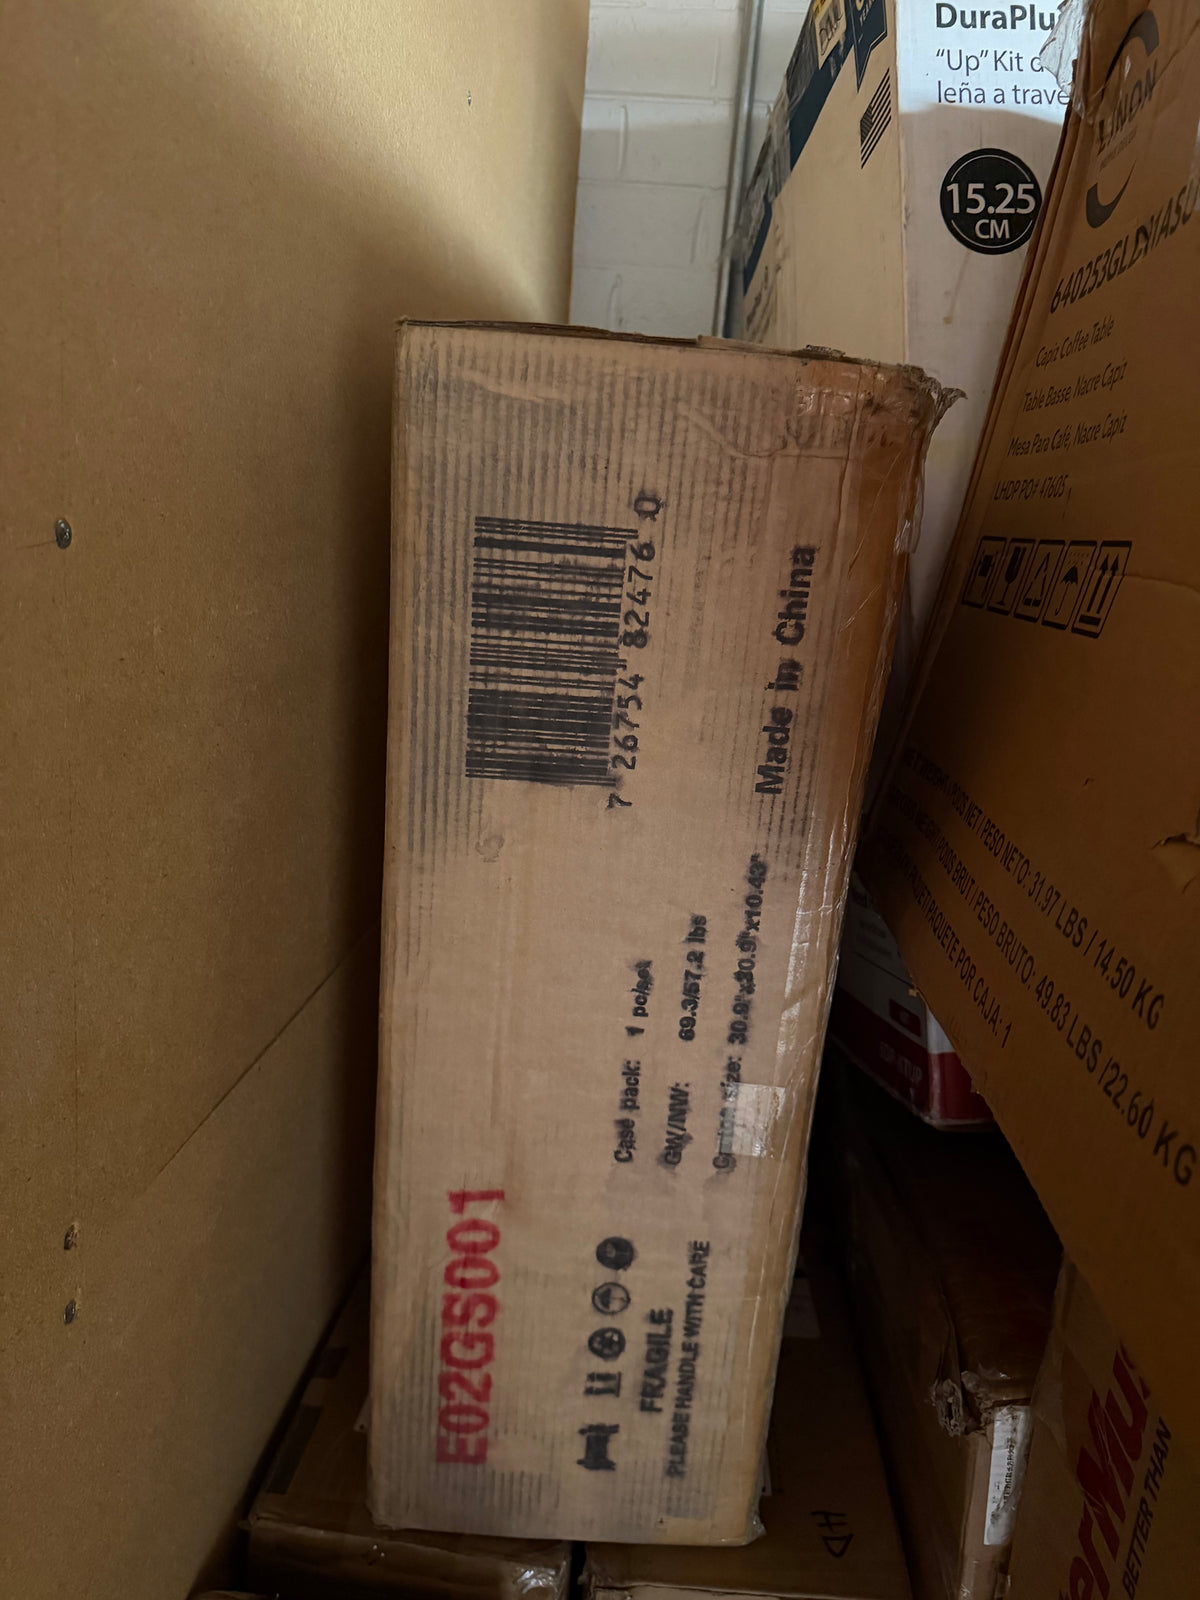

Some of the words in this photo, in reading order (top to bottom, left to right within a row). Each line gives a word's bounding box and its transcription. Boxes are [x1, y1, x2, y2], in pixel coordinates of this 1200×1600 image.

[936, 3, 1056, 31] DuraPlu
[994, 50, 1024, 72] Kit
[938, 80, 985, 104] leña
[993, 88, 1005, 104] a
[1012, 85, 1070, 105] trave
[946, 183, 1036, 215] 15.25
[975, 219, 1010, 239] CM
[1060, 330, 1089, 360] Coffee
[1091, 315, 1114, 344] Table
[1023, 388, 1044, 413] Table
[1045, 386, 1072, 408] Basse
[1073, 374, 1100, 399] Nacre
[1007, 437, 1031, 457] Mesa
[1031, 433, 1050, 454] Para
[1073, 422, 1100, 446] Nacre
[633, 495, 661, 520] 0
[620, 541, 656, 650] 82476
[773, 544, 818, 646] China
[766, 659, 804, 691] in
[611, 673, 645, 771] 26754
[755, 706, 794, 794] Made
[605, 793, 633, 810] 7
[687, 914, 708, 944] lbs
[963, 800, 983, 831] NET
[980, 817, 1005, 858] PESO
[999, 840, 1032, 889] NETO:
[1028, 871, 1061, 917] 31.97
[1055, 900, 1088, 948] LBS
[1093, 938, 1136, 999] 14.50
[1131, 978, 1165, 1031] KG
[954, 947, 977, 991] POR
[972, 977, 1003, 1037] CAJA:
[1001, 1021, 1013, 1049] 1
[625, 1025, 645, 1037] 1
[951, 859, 976, 901] BRUT
[973, 890, 1000, 937] PESO
[996, 920, 1037, 991] BRUTO:
[1034, 975, 1071, 1032] 49.83
[1066, 1013, 1103, 1074] LBS
[1152, 1120, 1197, 1187] KG
[621, 1060, 641, 1111] pack:
[613, 1118, 637, 1164] Case
[687, 1240, 711, 1290] CARE
[435, 1189, 505, 1465] E02GS001
[683, 1293, 705, 1340] WITH
[640, 1308, 675, 1413] FRAGILE
[675, 1341, 699, 1409] HANDLE
[666, 1411, 691, 1478] PLEASE
[1122, 1496, 1154, 1600] BETTER
[1143, 1415, 1173, 1503] THAN
